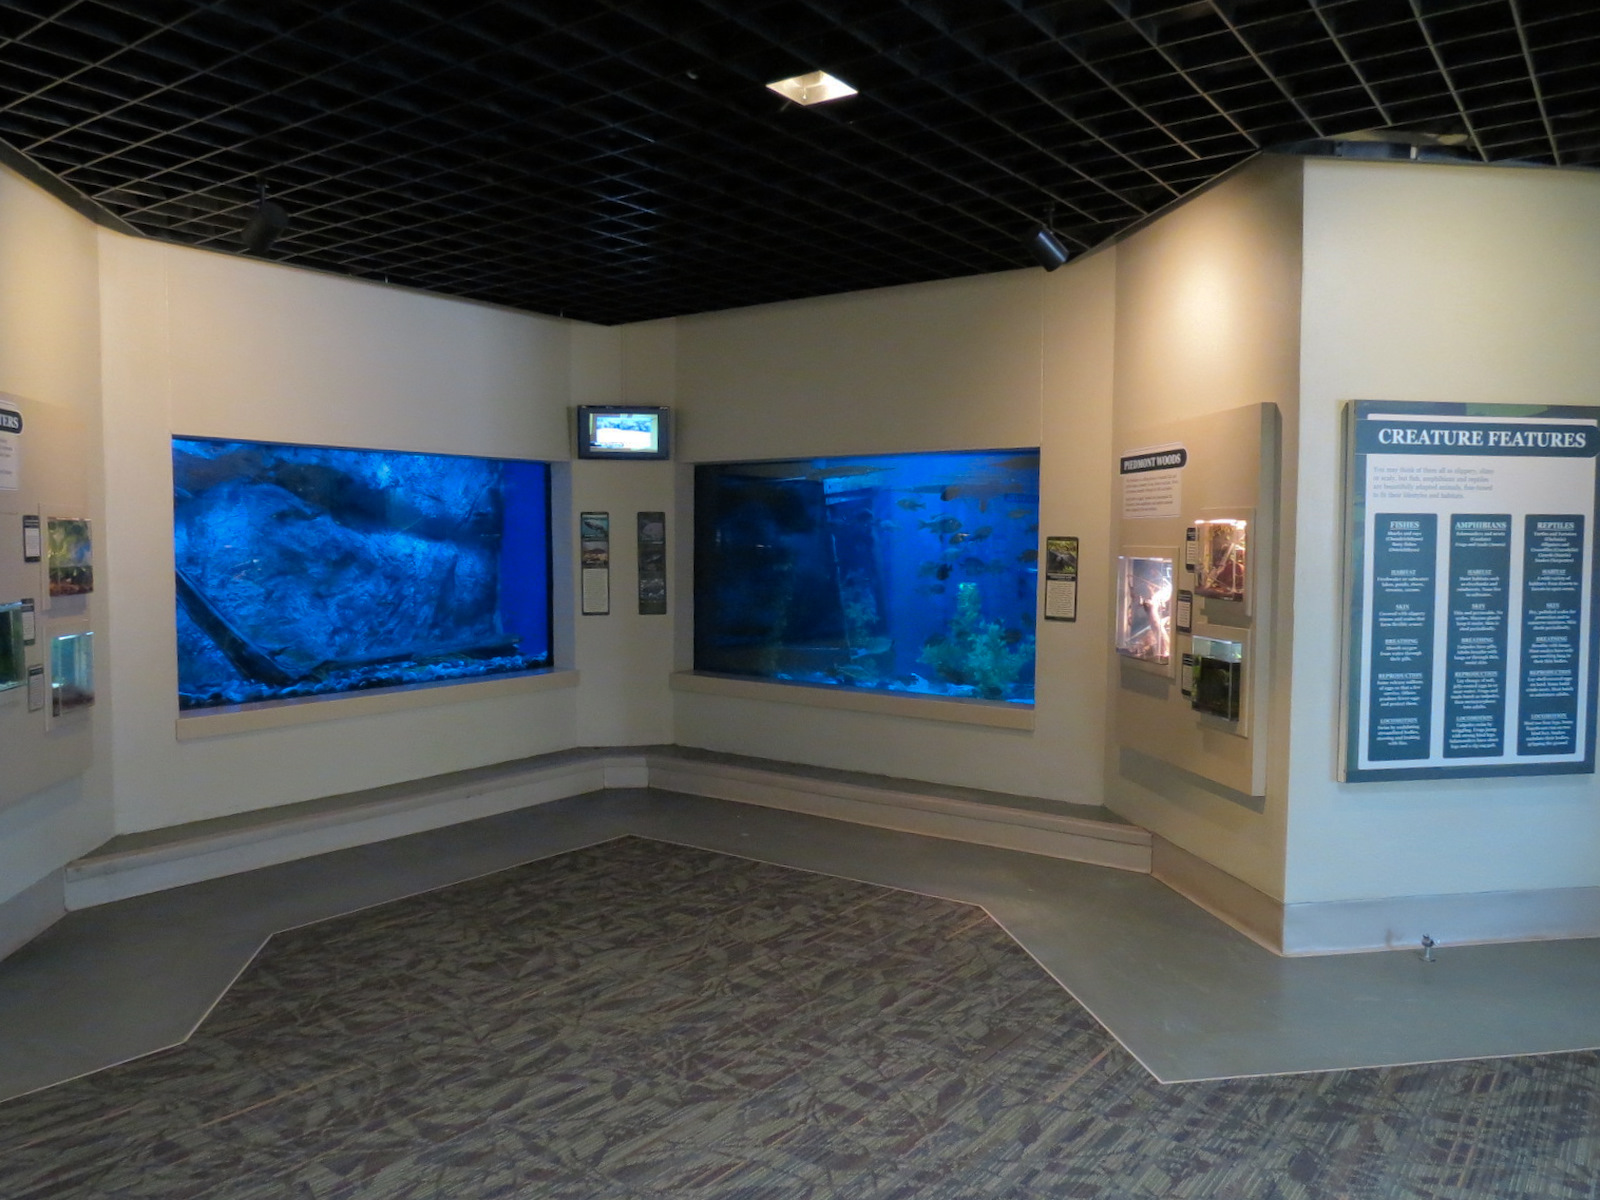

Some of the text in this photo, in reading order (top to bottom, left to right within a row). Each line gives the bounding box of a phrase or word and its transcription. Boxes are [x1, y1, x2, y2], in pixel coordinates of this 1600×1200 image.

[1378, 428, 1587, 448] CREATURE FEATURES
[1123, 453, 1182, 471] PIEDMONT WOODS
[1390, 521, 1420, 529] FISHES
[1455, 522, 1507, 530] AMPHIBIANS
[1537, 522, 1575, 530] REPTILES
